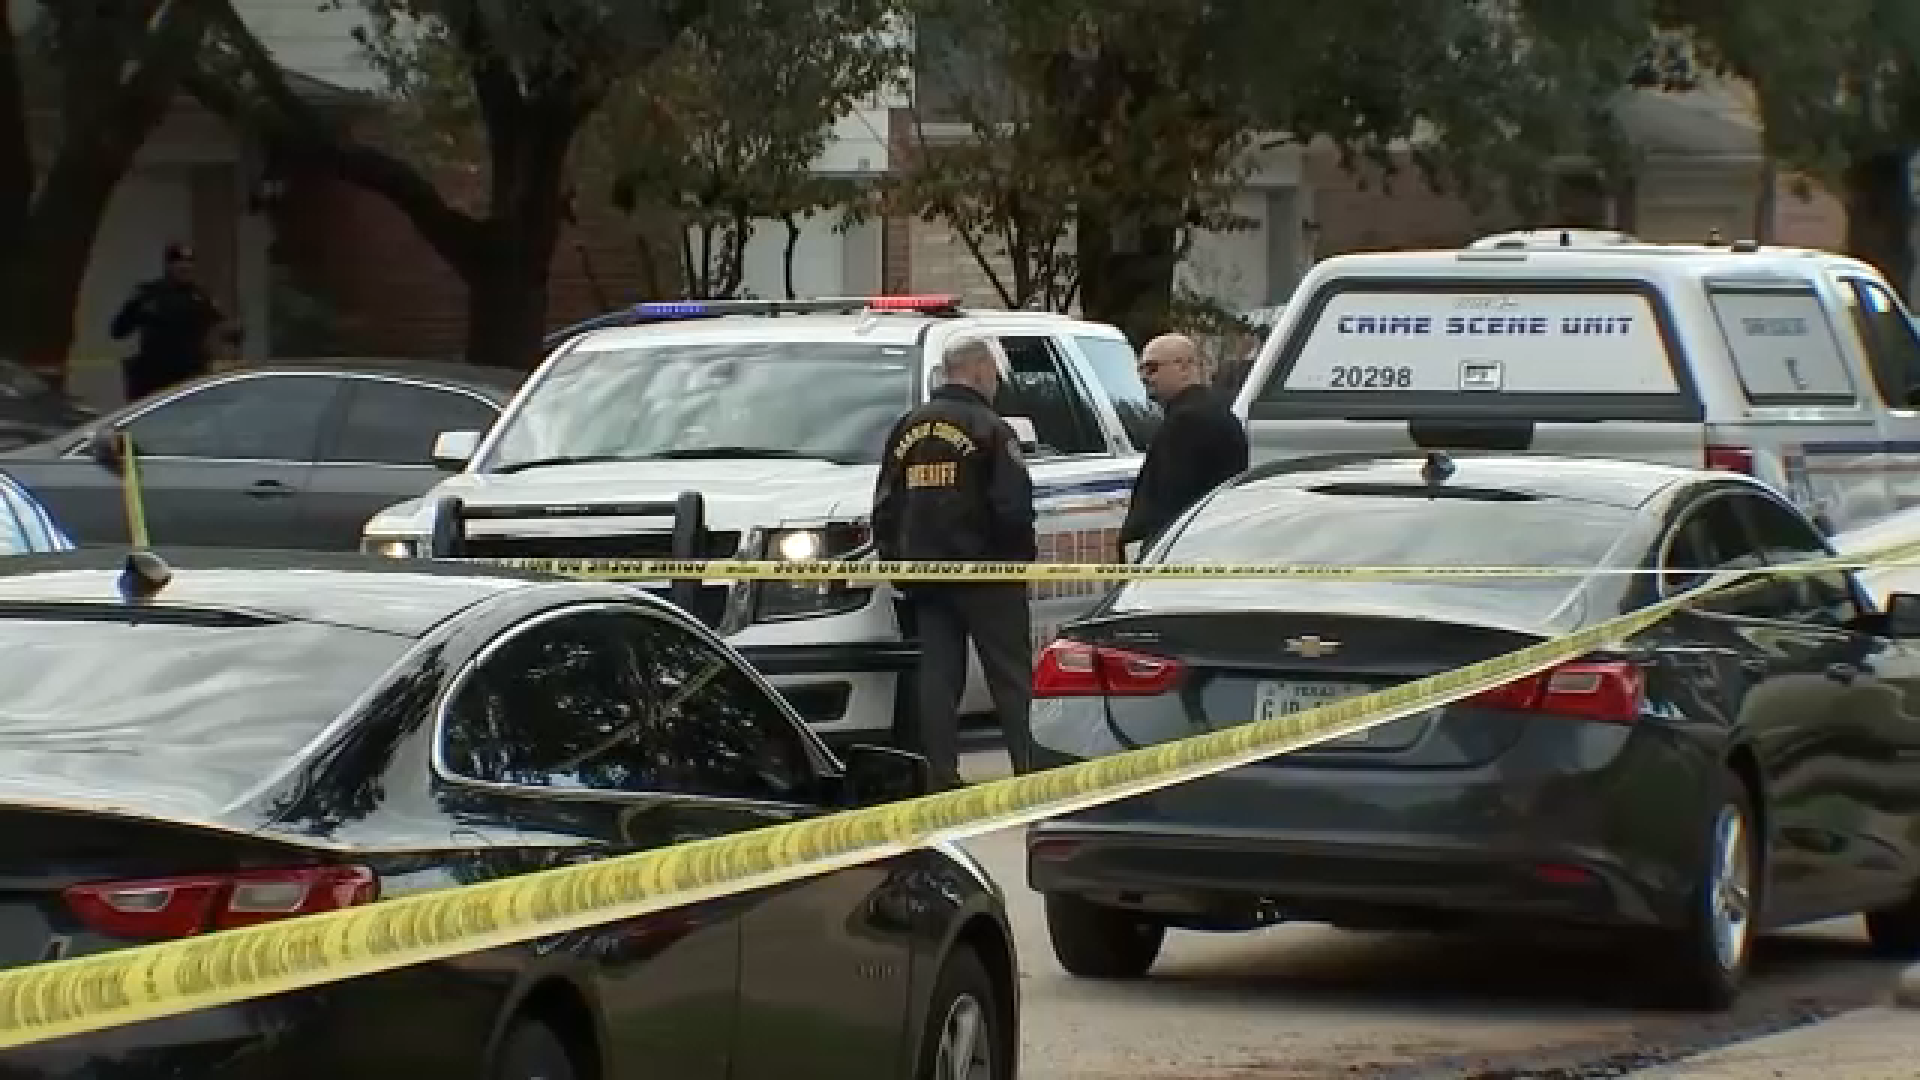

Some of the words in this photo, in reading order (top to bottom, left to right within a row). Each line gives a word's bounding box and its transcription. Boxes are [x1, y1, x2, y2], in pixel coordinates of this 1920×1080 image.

[1337, 315, 1432, 335] CRIME
[1445, 316, 1549, 335] SCENE
[1561, 316, 1633, 335] UNIT
[1331, 365, 1413, 388] 20298
